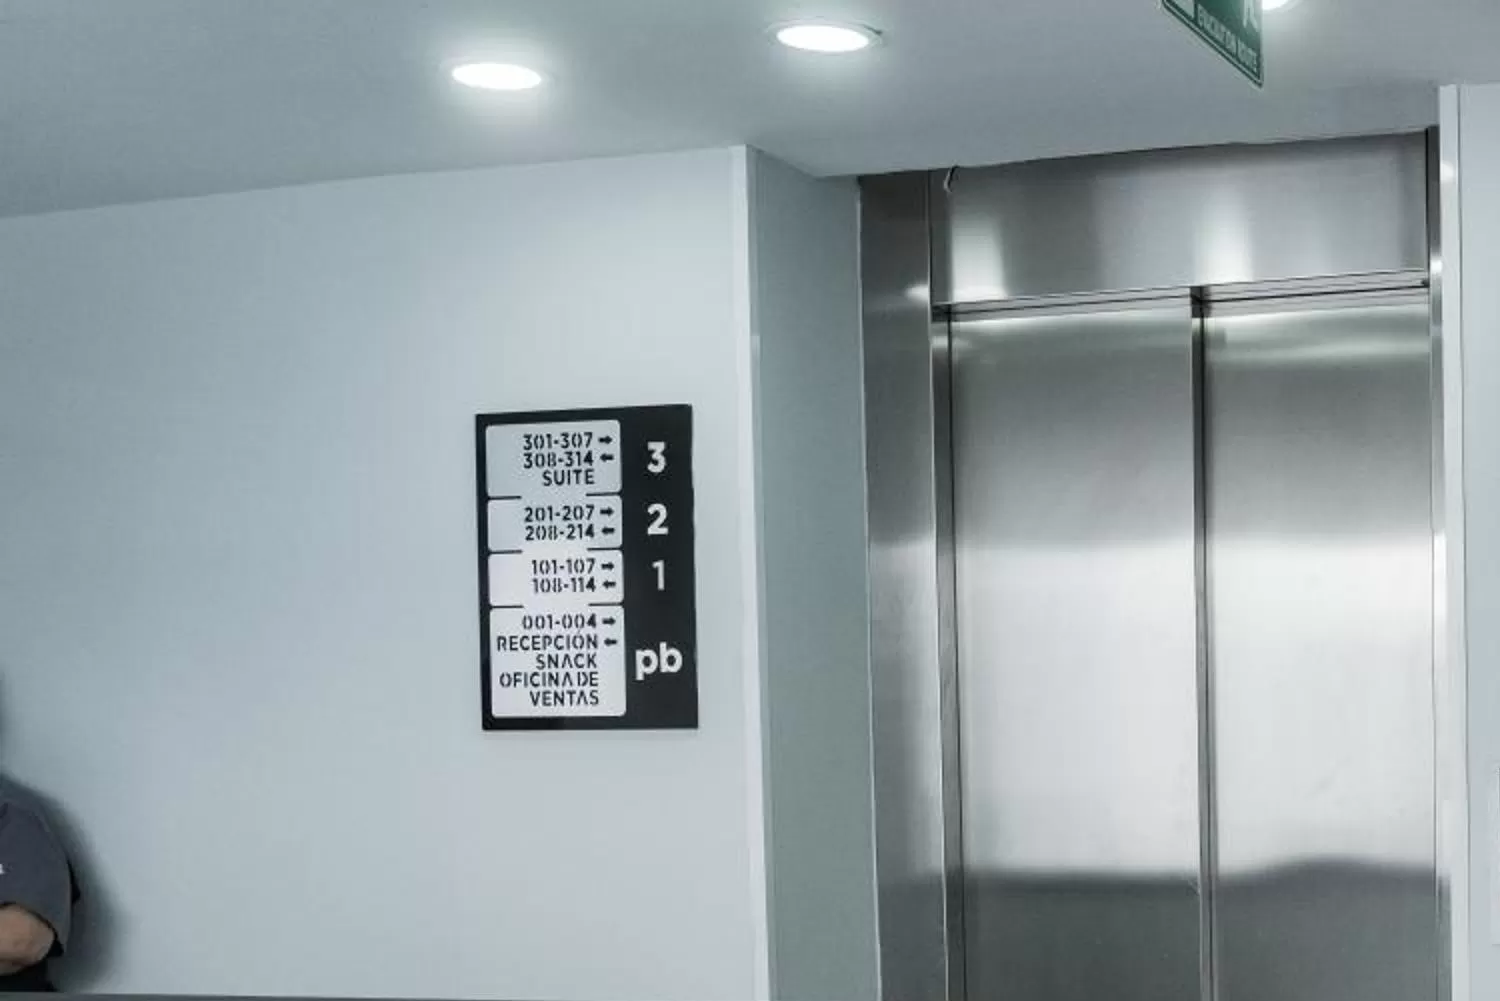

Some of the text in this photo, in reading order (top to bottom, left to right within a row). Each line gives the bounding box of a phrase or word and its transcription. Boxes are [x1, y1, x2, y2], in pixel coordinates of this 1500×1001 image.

[523, 432, 593, 451] 301-307
[523, 451, 594, 468] 308-314
[647, 441, 667, 473] 3
[542, 469, 595, 486] SUITE
[524, 505, 595, 523] 201-207
[647, 503, 669, 535] 2
[525, 524, 596, 541] 208-214
[531, 558, 596, 575] 101-107
[652, 560, 665, 591] 1
[533, 576, 597, 593] 108-114
[522, 614, 597, 630] 001-004
[497, 631, 598, 651] RECEPCIÓN
[536, 653, 598, 670] SNACK
[635, 643, 683, 681] pb
[499, 671, 599, 689] OFICINA DE
[529, 690, 599, 707] VENTAS
